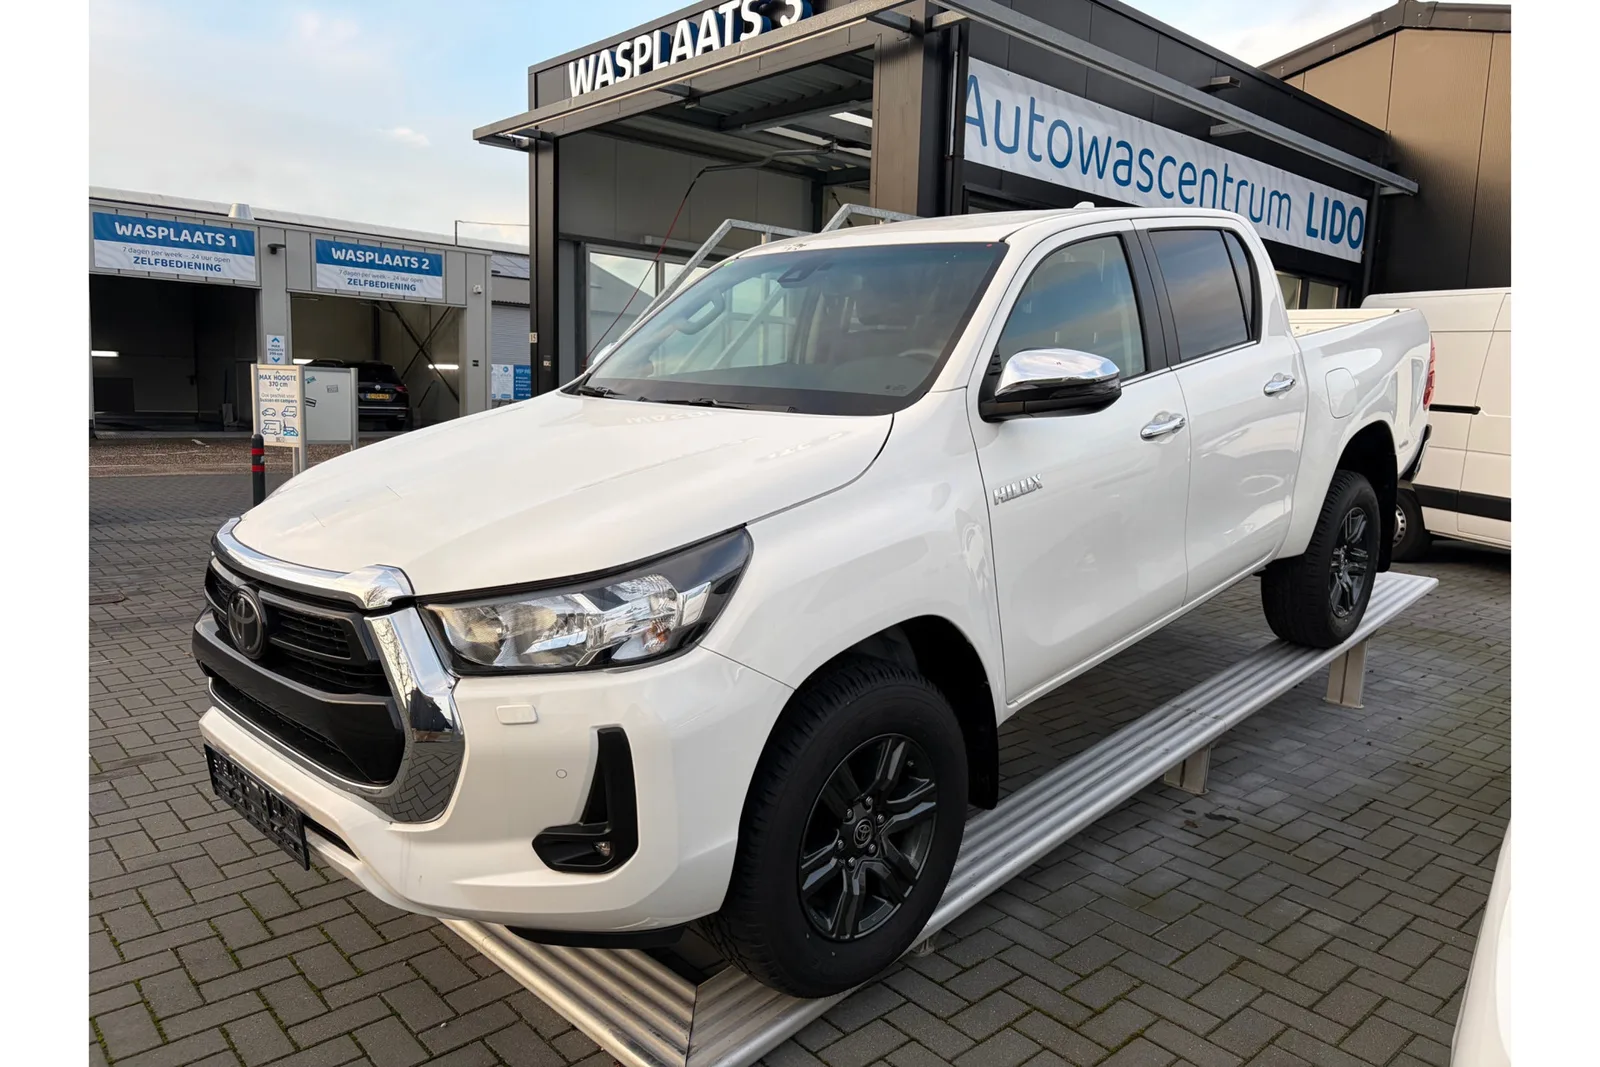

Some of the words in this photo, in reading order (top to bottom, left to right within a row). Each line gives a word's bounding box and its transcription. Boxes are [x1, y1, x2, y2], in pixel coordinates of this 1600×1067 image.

[568, 0, 768, 98] WASPLAATS
[965, 74, 1292, 232] Autowascentrum
[1306, 192, 1364, 249] LIDO
[114, 221, 226, 247] WASPLAATS
[229, 235, 237, 248] 1
[128, 247, 150, 256] dagen
[331, 247, 419, 269] WASPLAATS
[421, 258, 430, 270] 2
[133, 256, 222, 272] ZELFBEDIENING
[347, 277, 416, 292] ZELFBEDIENING
[273, 374, 297, 382] HOOGTE
[993, 473, 1043, 506] HILUX
